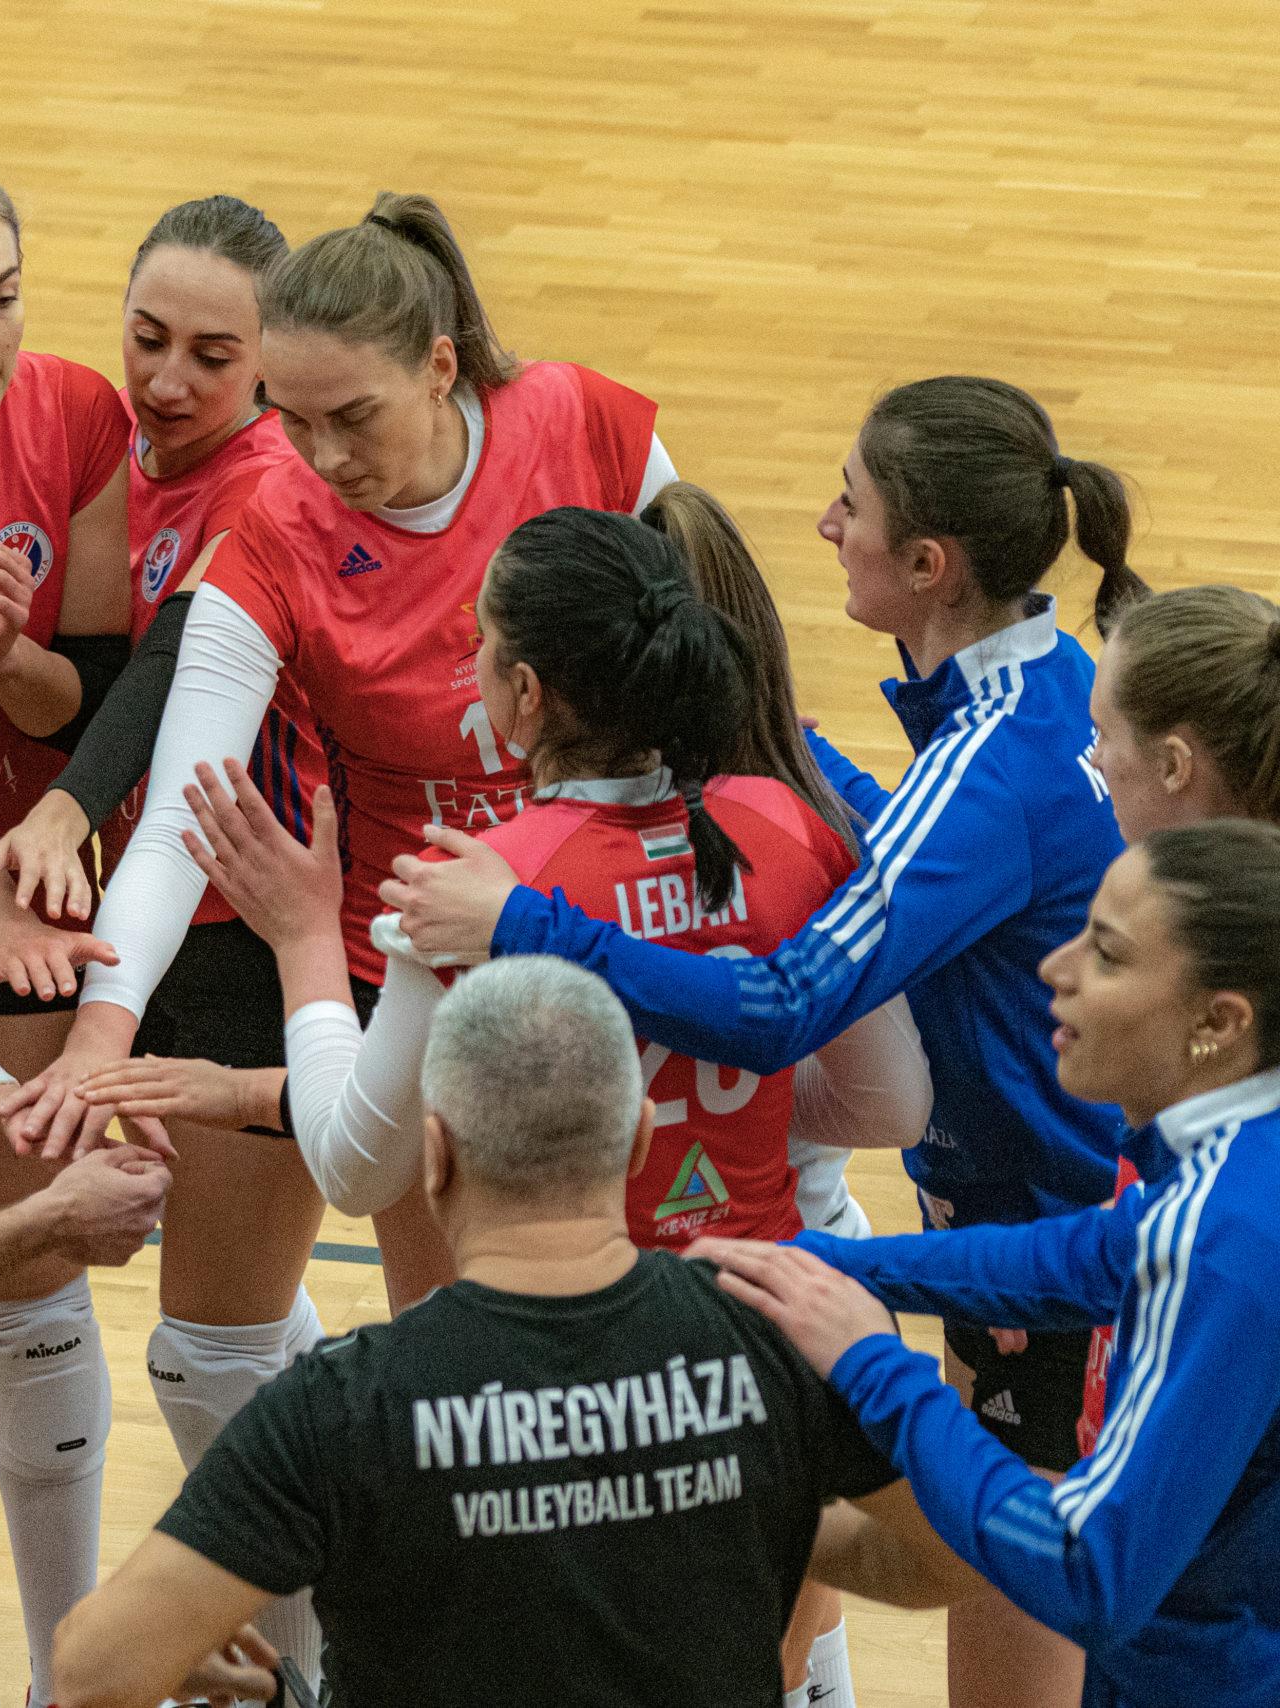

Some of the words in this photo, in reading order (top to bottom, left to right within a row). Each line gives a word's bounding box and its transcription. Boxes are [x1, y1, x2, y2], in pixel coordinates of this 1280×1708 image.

[338, 561, 382, 578] adidas
[147, 1360, 186, 1383] IKASA
[412, 1354, 769, 1471] NYÍREGYHÁZA
[980, 1402, 1022, 1427] adidas
[451, 1470, 654, 1539] VOLLEYBALL
[653, 1453, 744, 1514] TEAM
